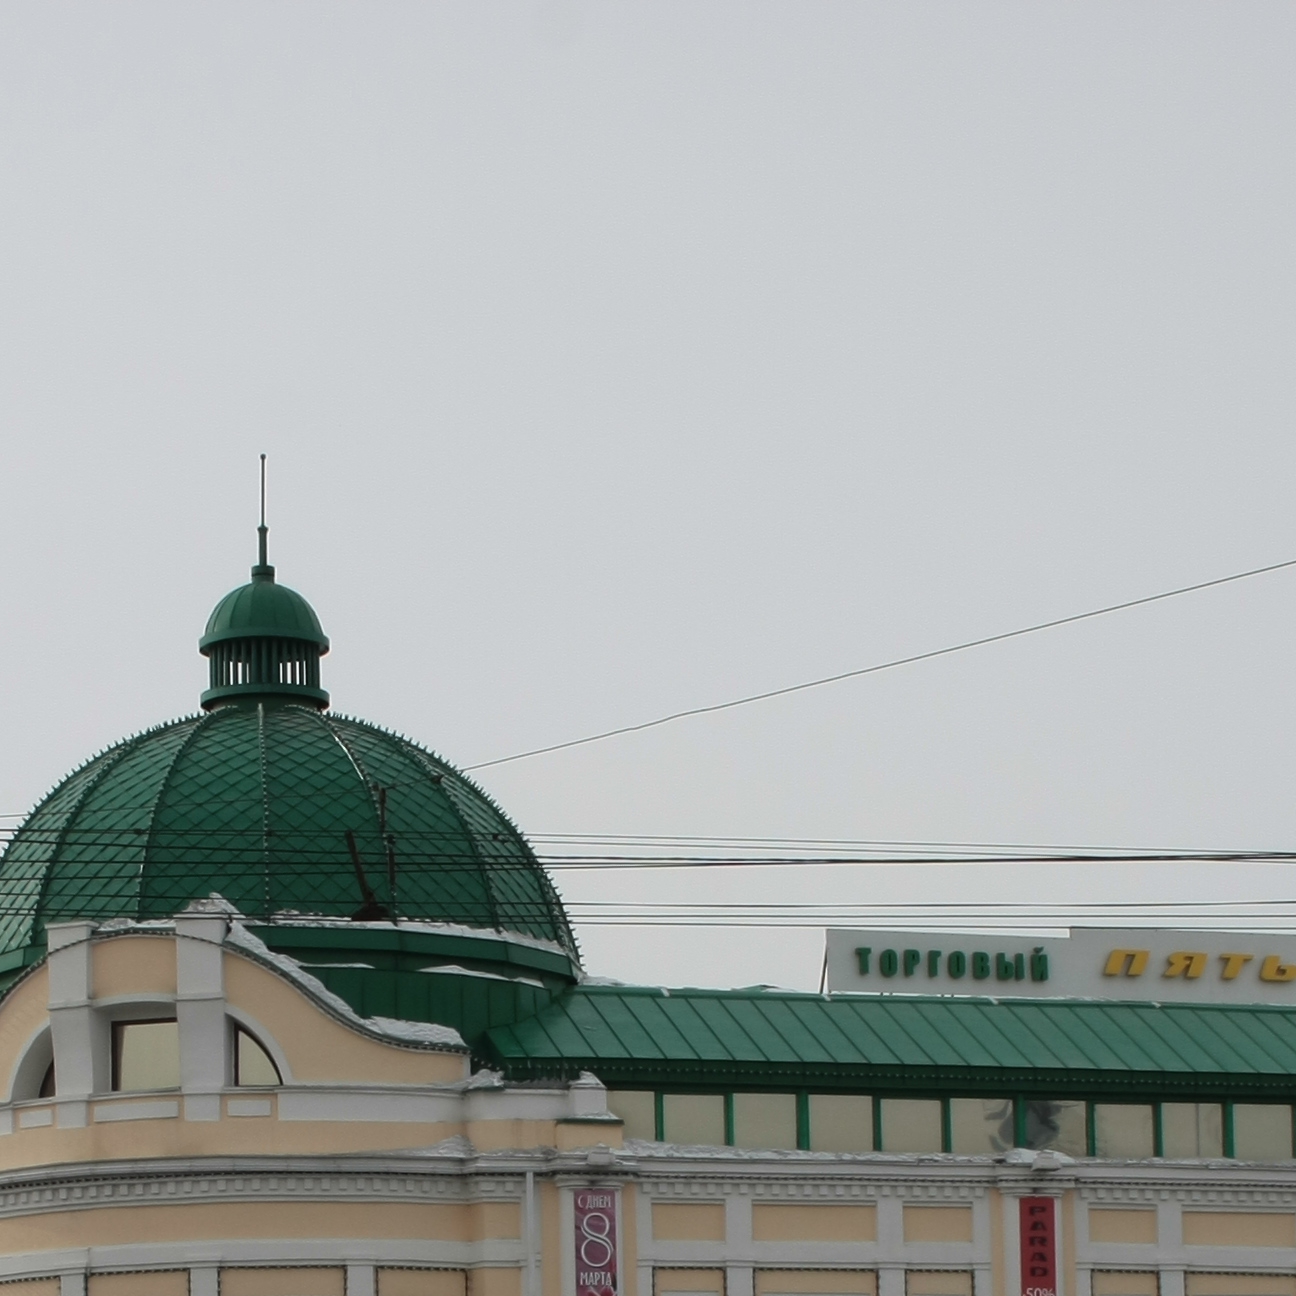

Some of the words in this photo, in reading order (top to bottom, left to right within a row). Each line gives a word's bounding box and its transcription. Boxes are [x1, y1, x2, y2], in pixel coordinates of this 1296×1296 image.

[855, 946, 1049, 982] ТОРГОВЫЙ
[586, 1195, 611, 1209] ДНЕМ
[581, 1212, 614, 1267] 8
[1028, 1205, 1048, 1277] PARAD
[580, 1271, 612, 1286] МАРТА
